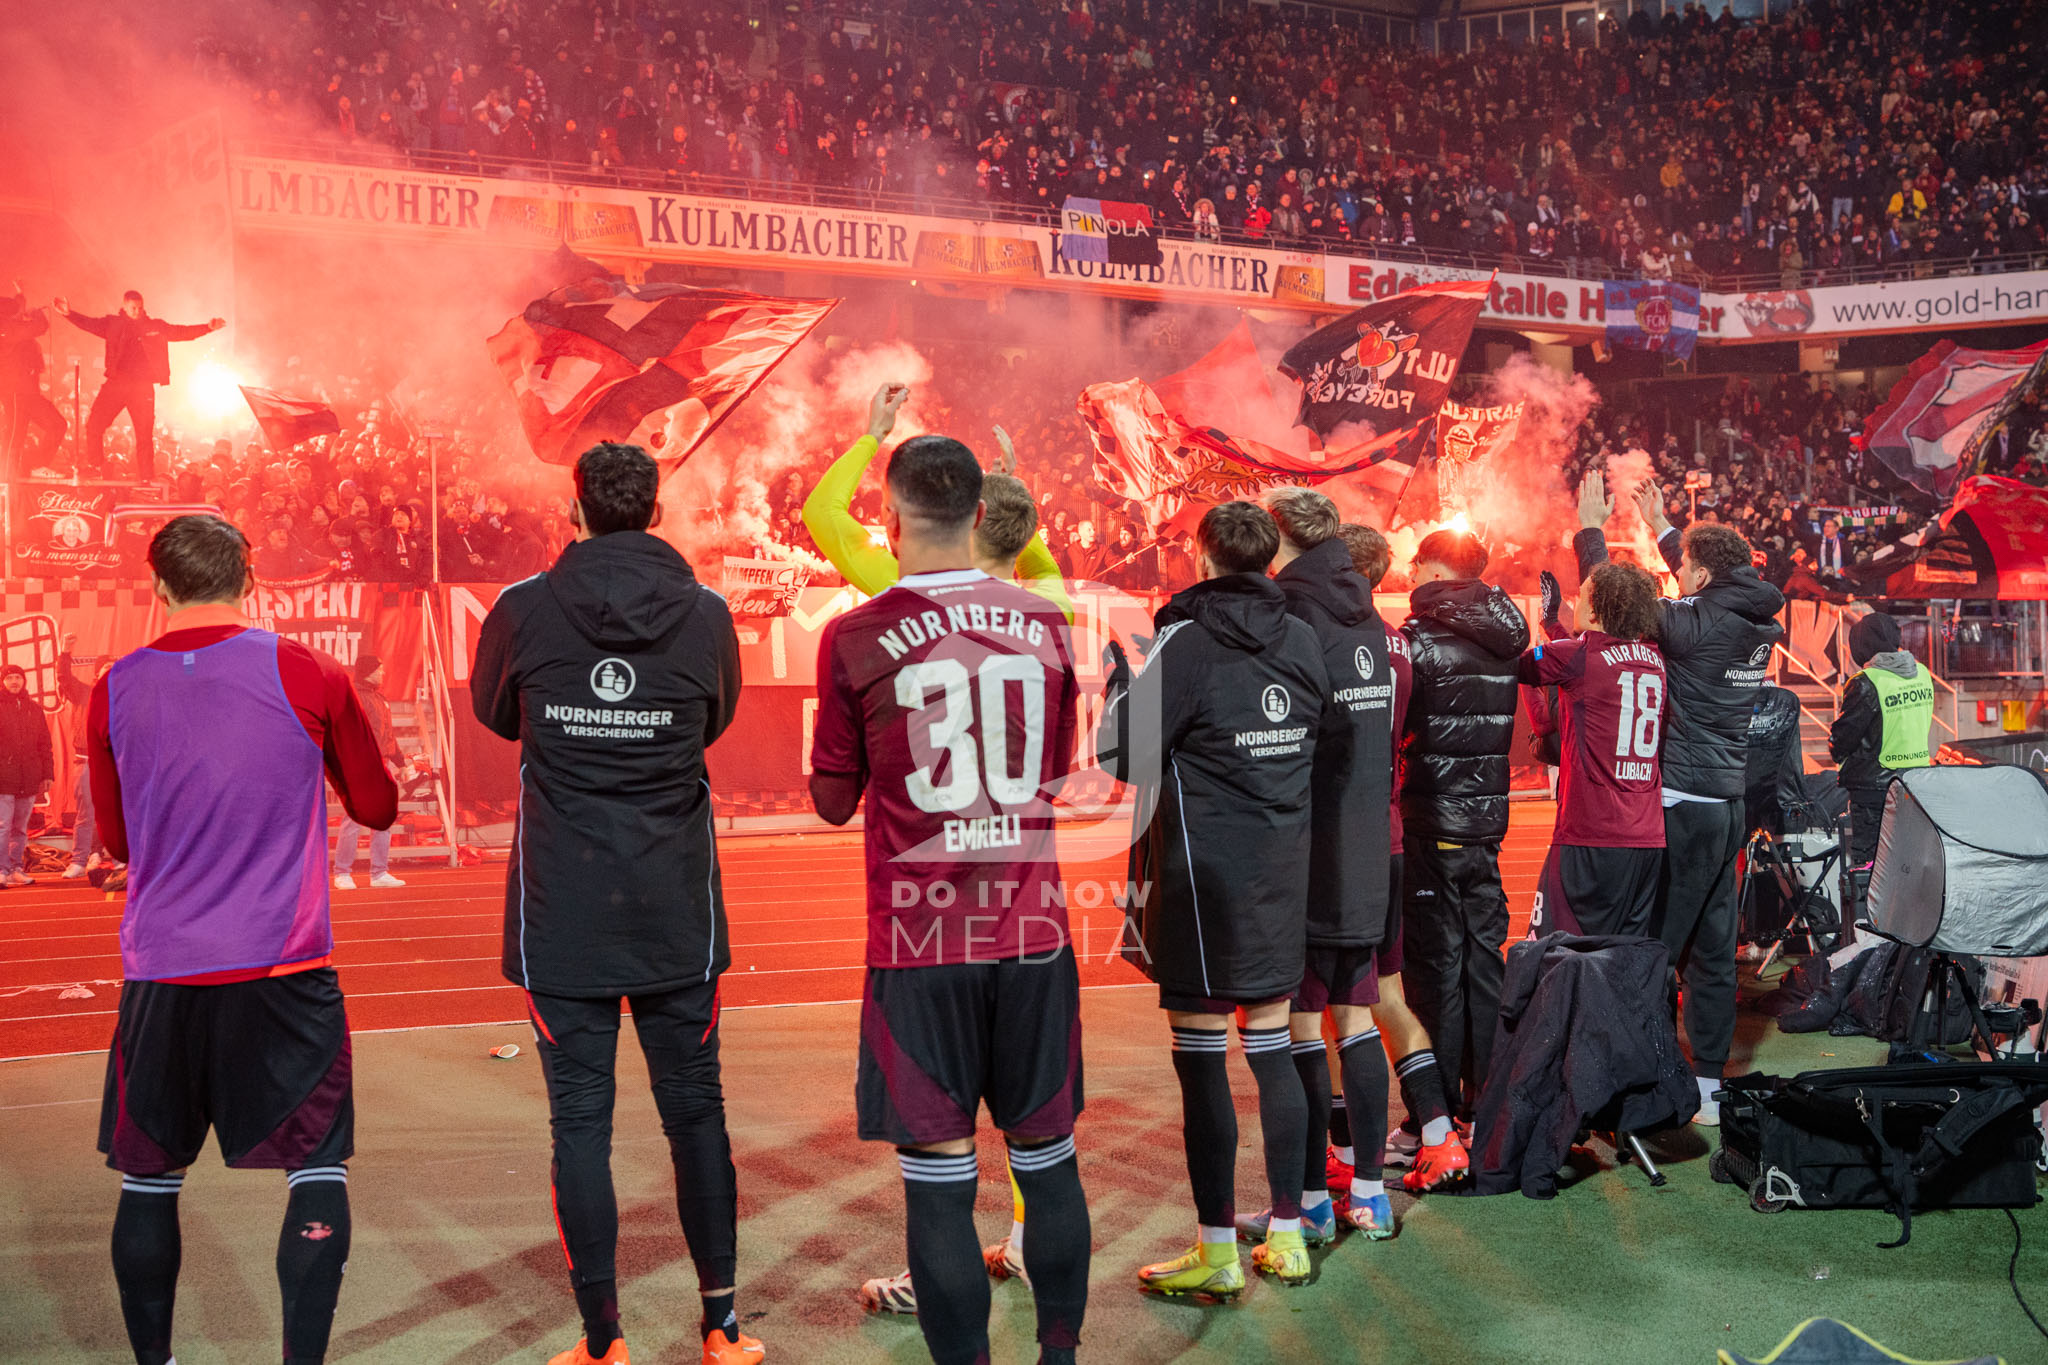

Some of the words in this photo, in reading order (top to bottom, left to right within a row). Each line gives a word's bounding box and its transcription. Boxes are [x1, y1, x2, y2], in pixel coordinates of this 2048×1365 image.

[648, 196, 909, 262] KULMBACHER
[1068, 212, 1149, 238] PINOLA
[241, 581, 365, 620] RESPEKT
[877, 603, 1045, 661] NÜRNBERG
[1334, 684, 1392, 704] NÜRNBERGER
[1347, 699, 1388, 712] VERSICHERUNG
[545, 703, 673, 726] NÜRNBERGER
[1616, 670, 1663, 758] 18
[562, 724, 655, 739] VERSICHERUNG
[893, 654, 1046, 814] 30
[1235, 727, 1308, 747] NÜRNBERGER
[1250, 743, 1301, 758] VERSICHERUNG
[1615, 761, 1653, 782] LUBACH
[943, 813, 1022, 853] EMRELI
